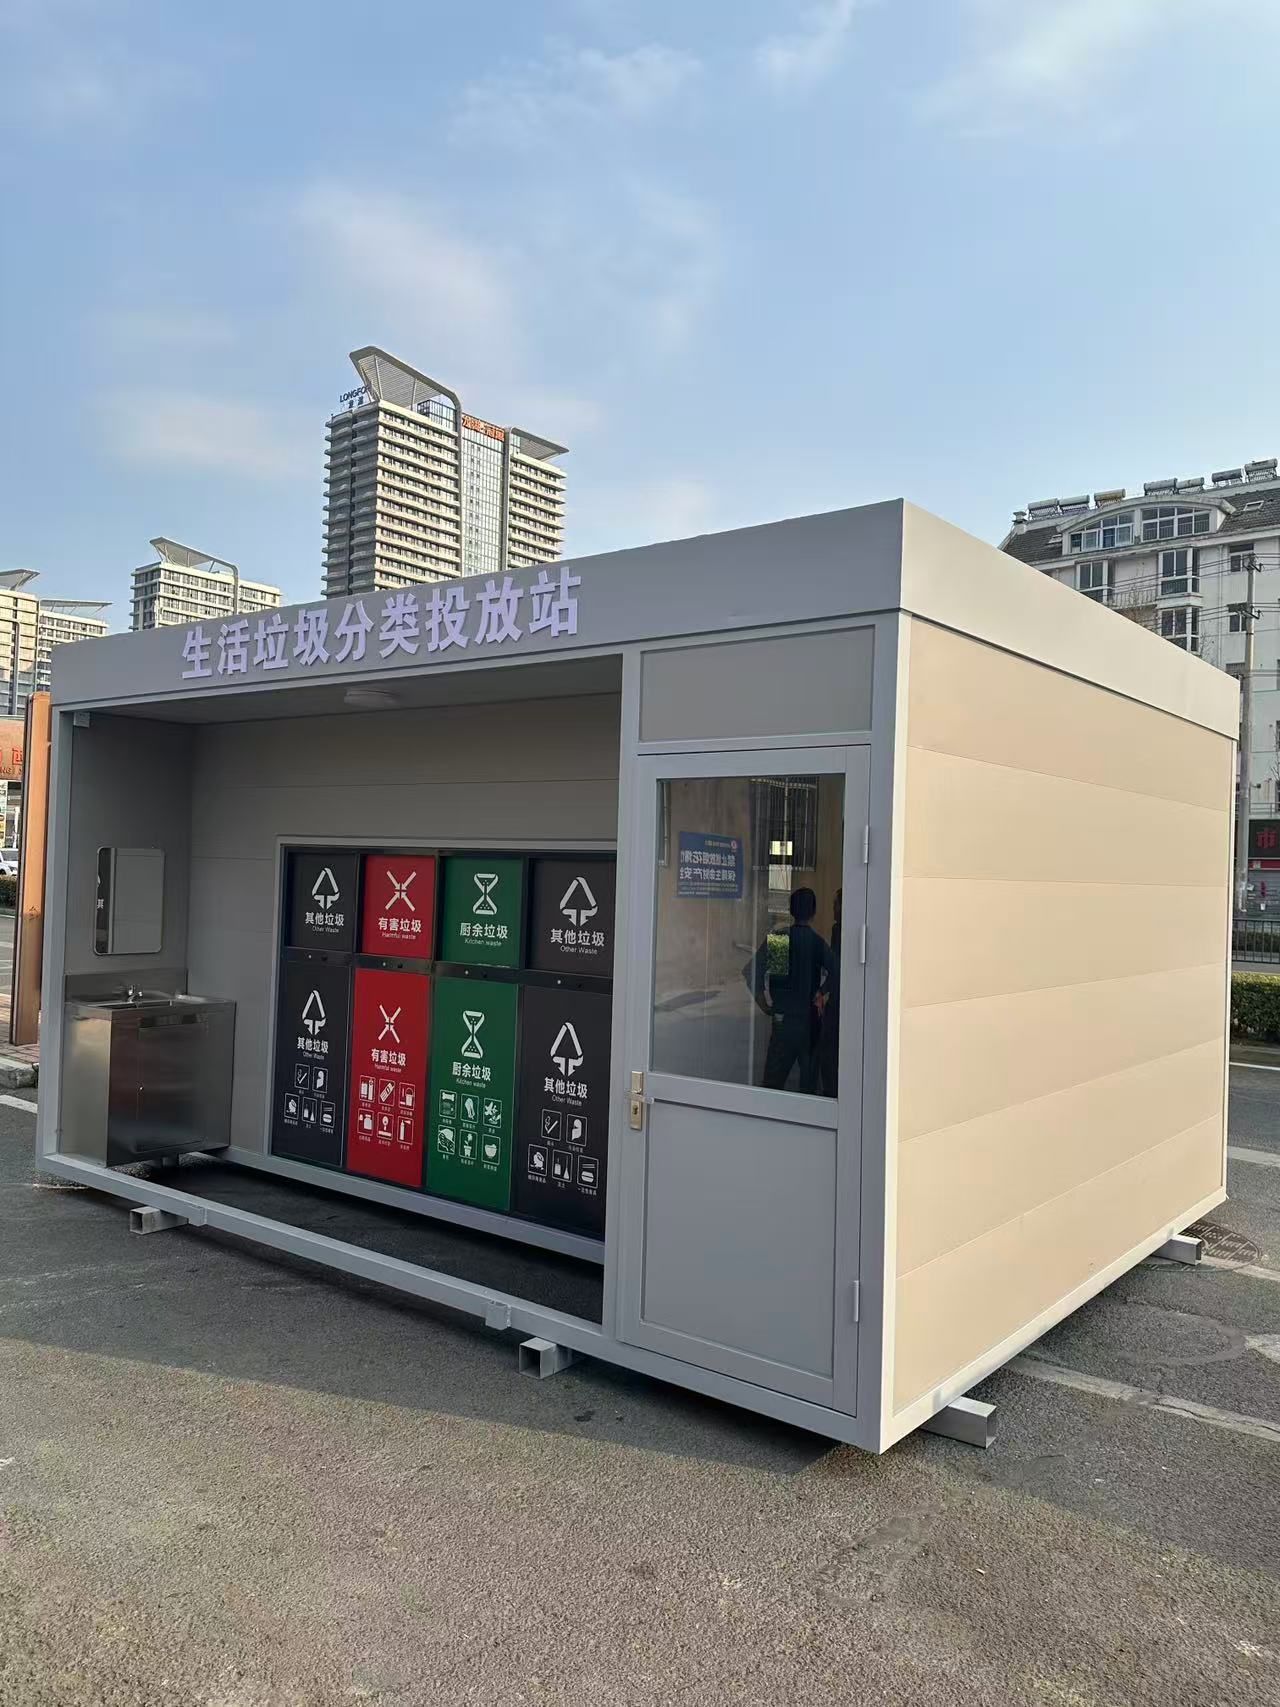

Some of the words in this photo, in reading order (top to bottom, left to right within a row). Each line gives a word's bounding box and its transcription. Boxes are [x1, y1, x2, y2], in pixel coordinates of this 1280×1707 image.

[181, 566, 582, 680] 生活垃圾分类投放站
[305, 912, 344, 927] 其他垃圾
[378, 917, 421, 933] 有害垃圾
[312, 925, 325, 933] Other
[460, 922, 508, 939] 厨余垃圾
[550, 928, 605, 947] 其他垃圾
[560, 945, 577, 953] Other
[578, 947, 598, 955] Waste
[297, 1036, 329, 1054] 其他垃圾
[371, 1048, 407, 1066] 有害垃圾
[452, 1061, 491, 1081] 厨余垃圾
[544, 1077, 588, 1099] 其他垃圾
[552, 1095, 566, 1103] Other
